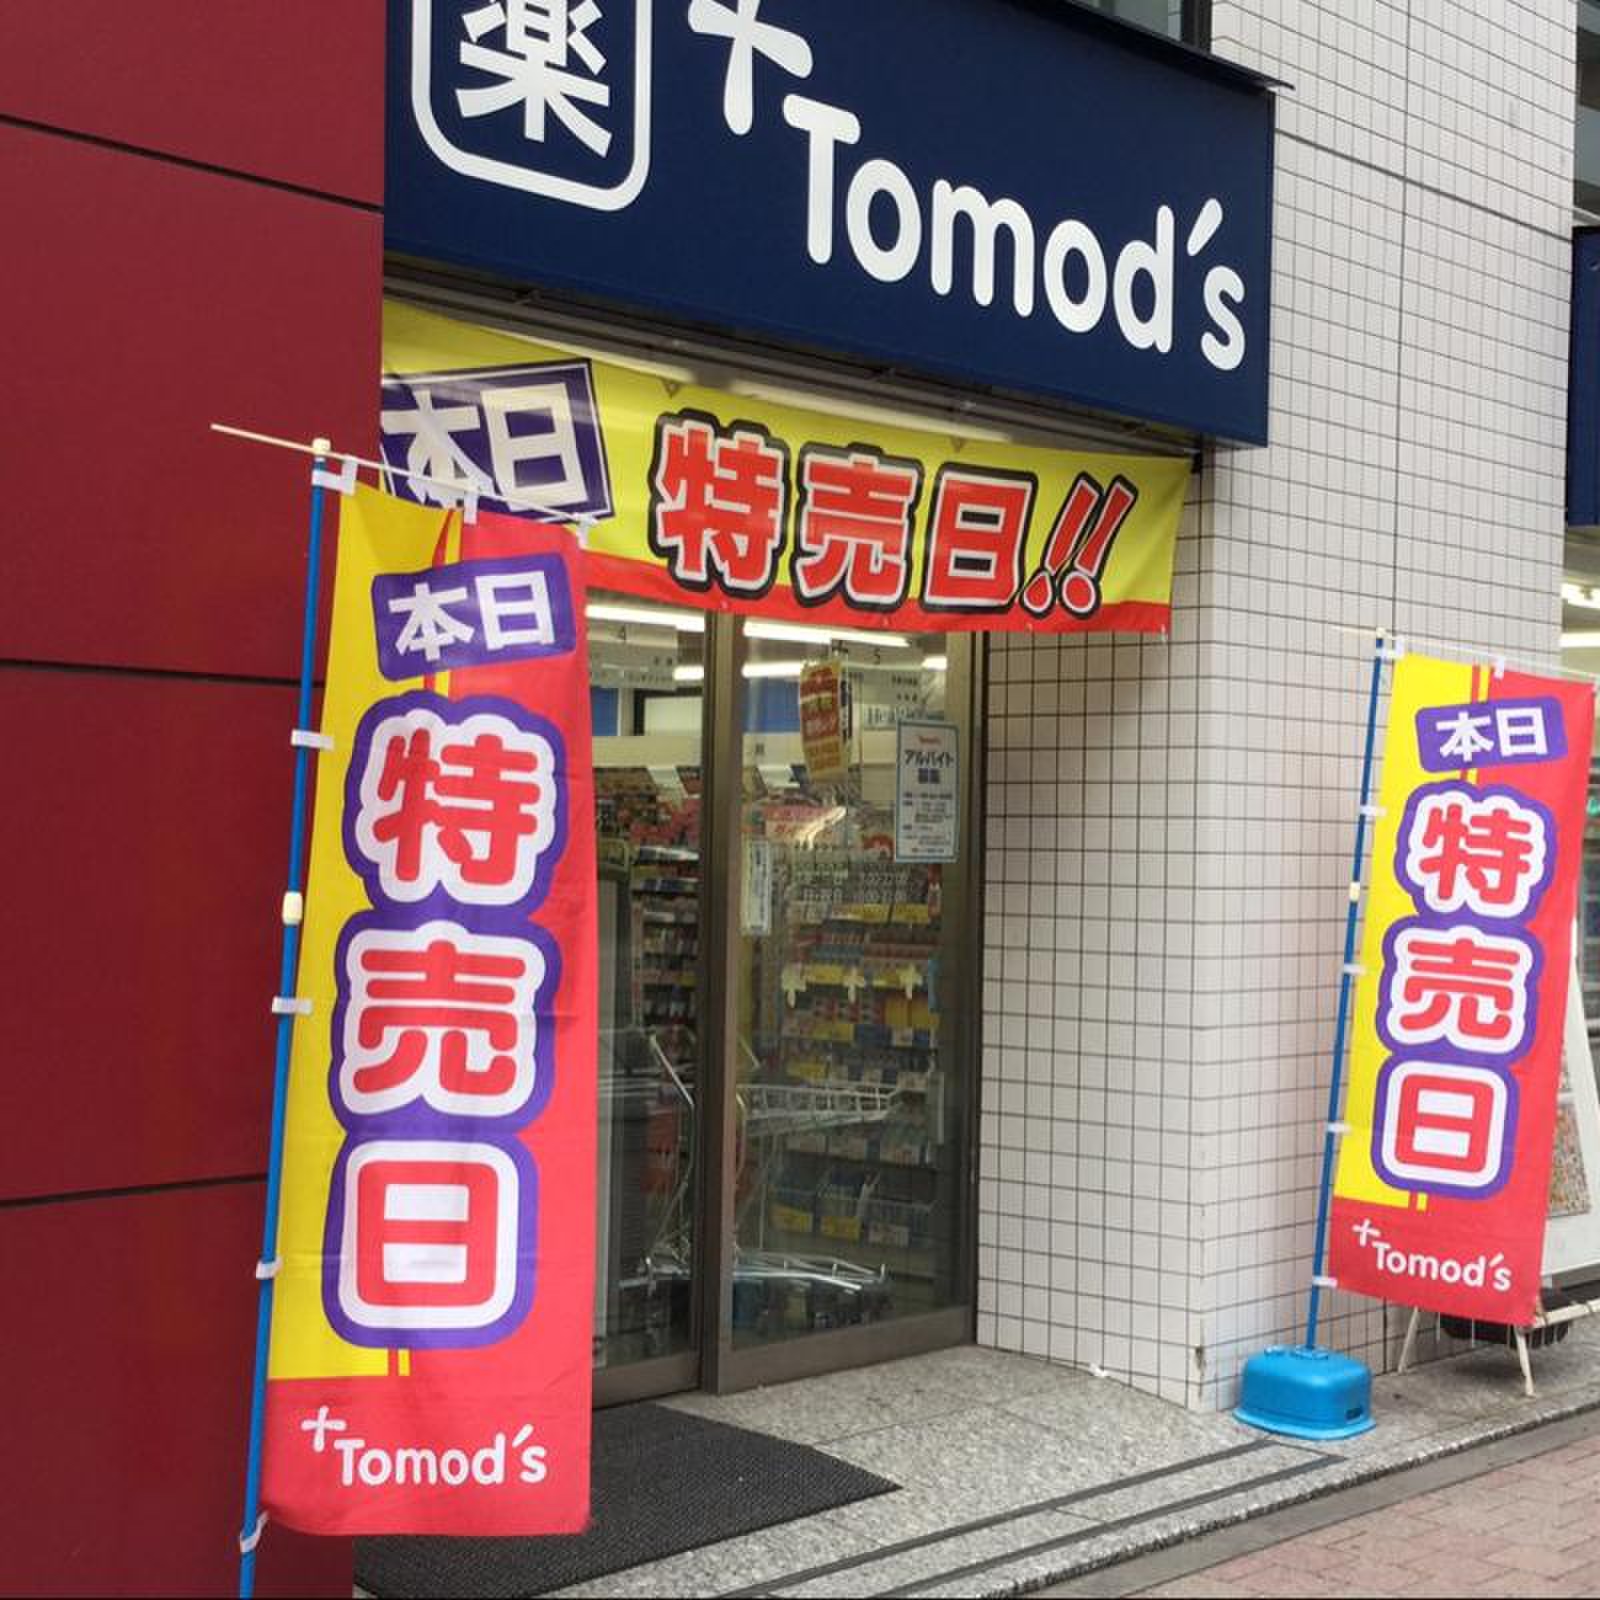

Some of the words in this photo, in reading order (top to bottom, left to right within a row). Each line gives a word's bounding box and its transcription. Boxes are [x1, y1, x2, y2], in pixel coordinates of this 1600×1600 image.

[783, 94, 1245, 371] Tomod's
[381, 383, 589, 512] 本日
[653, 417, 1138, 614] 特売日!!
[388, 571, 556, 662] 本日
[1435, 707, 1549, 762] 本日
[339, 709, 557, 1328] 特売日
[1382, 791, 1546, 1188] 特売日
[1371, 1241, 1512, 1291] Tomod's
[333, 1424, 547, 1486] Tomod's
